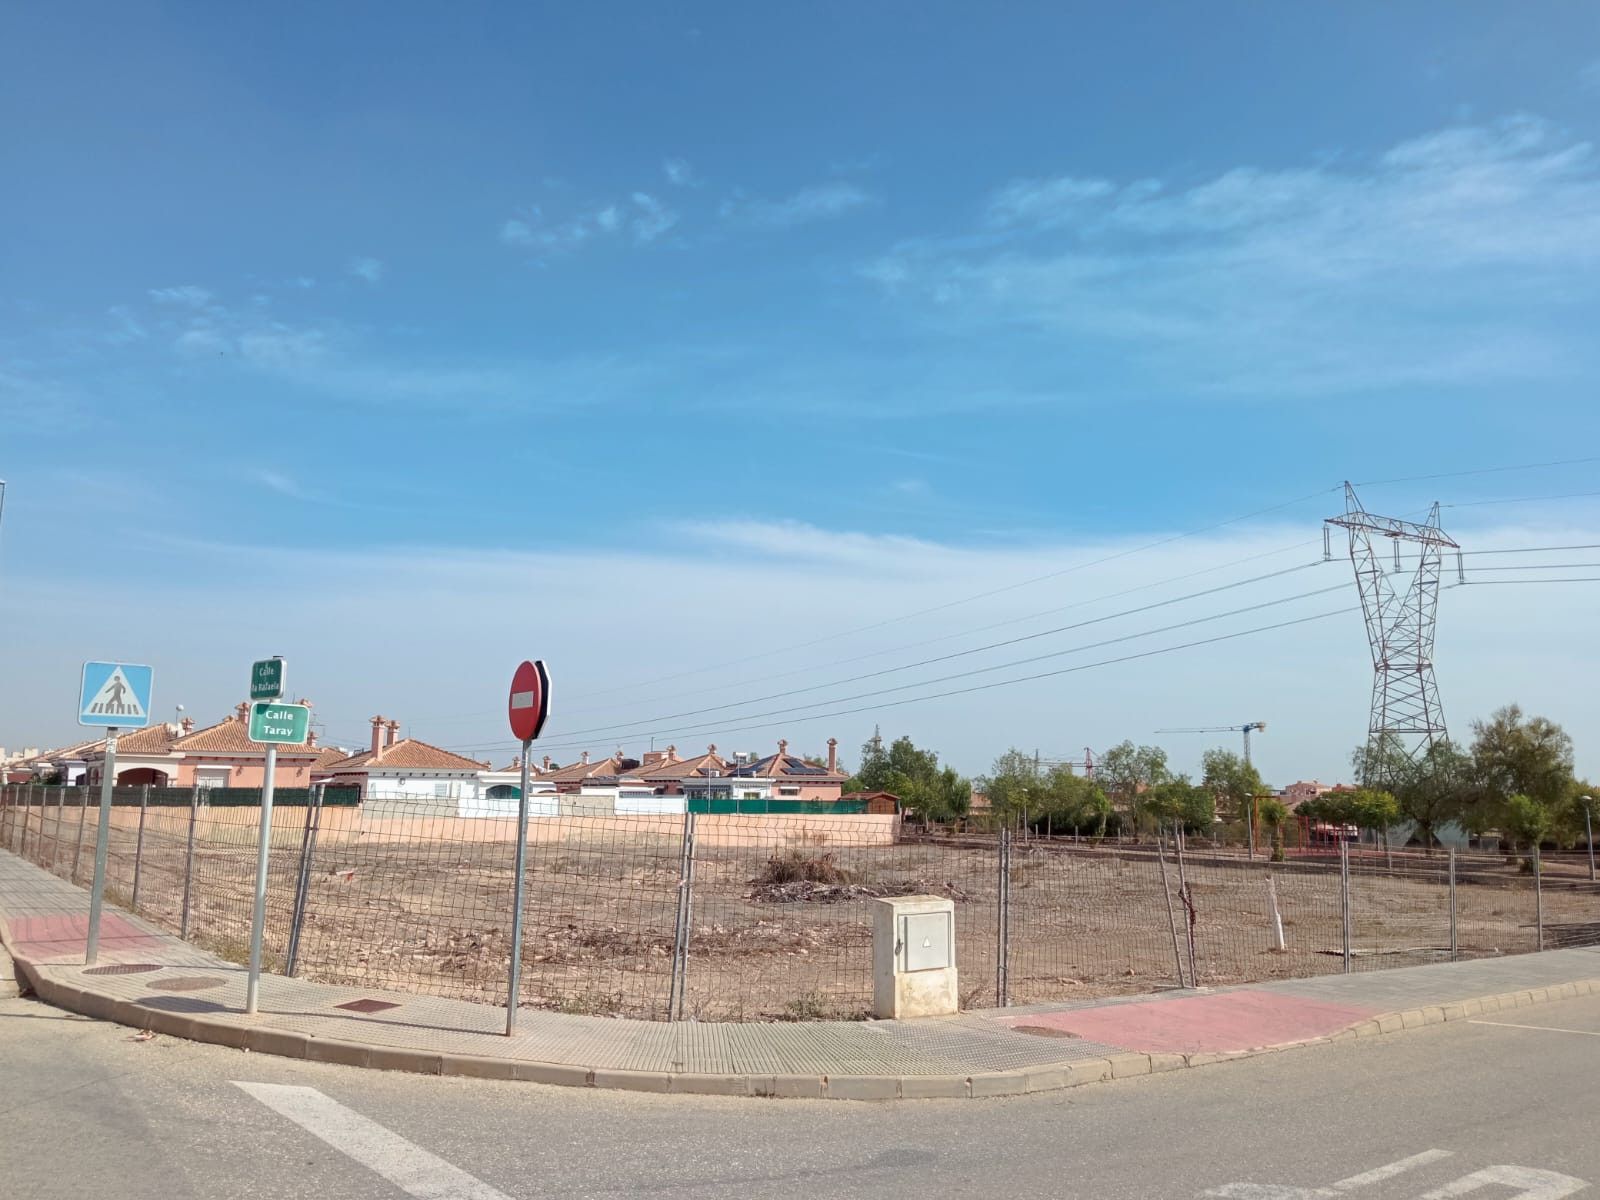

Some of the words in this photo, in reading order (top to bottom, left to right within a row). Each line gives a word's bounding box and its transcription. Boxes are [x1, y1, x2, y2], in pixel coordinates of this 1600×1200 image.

[259, 667, 275, 677] Calle
[266, 711, 293, 720] Calle
[264, 726, 293, 736] Taray
